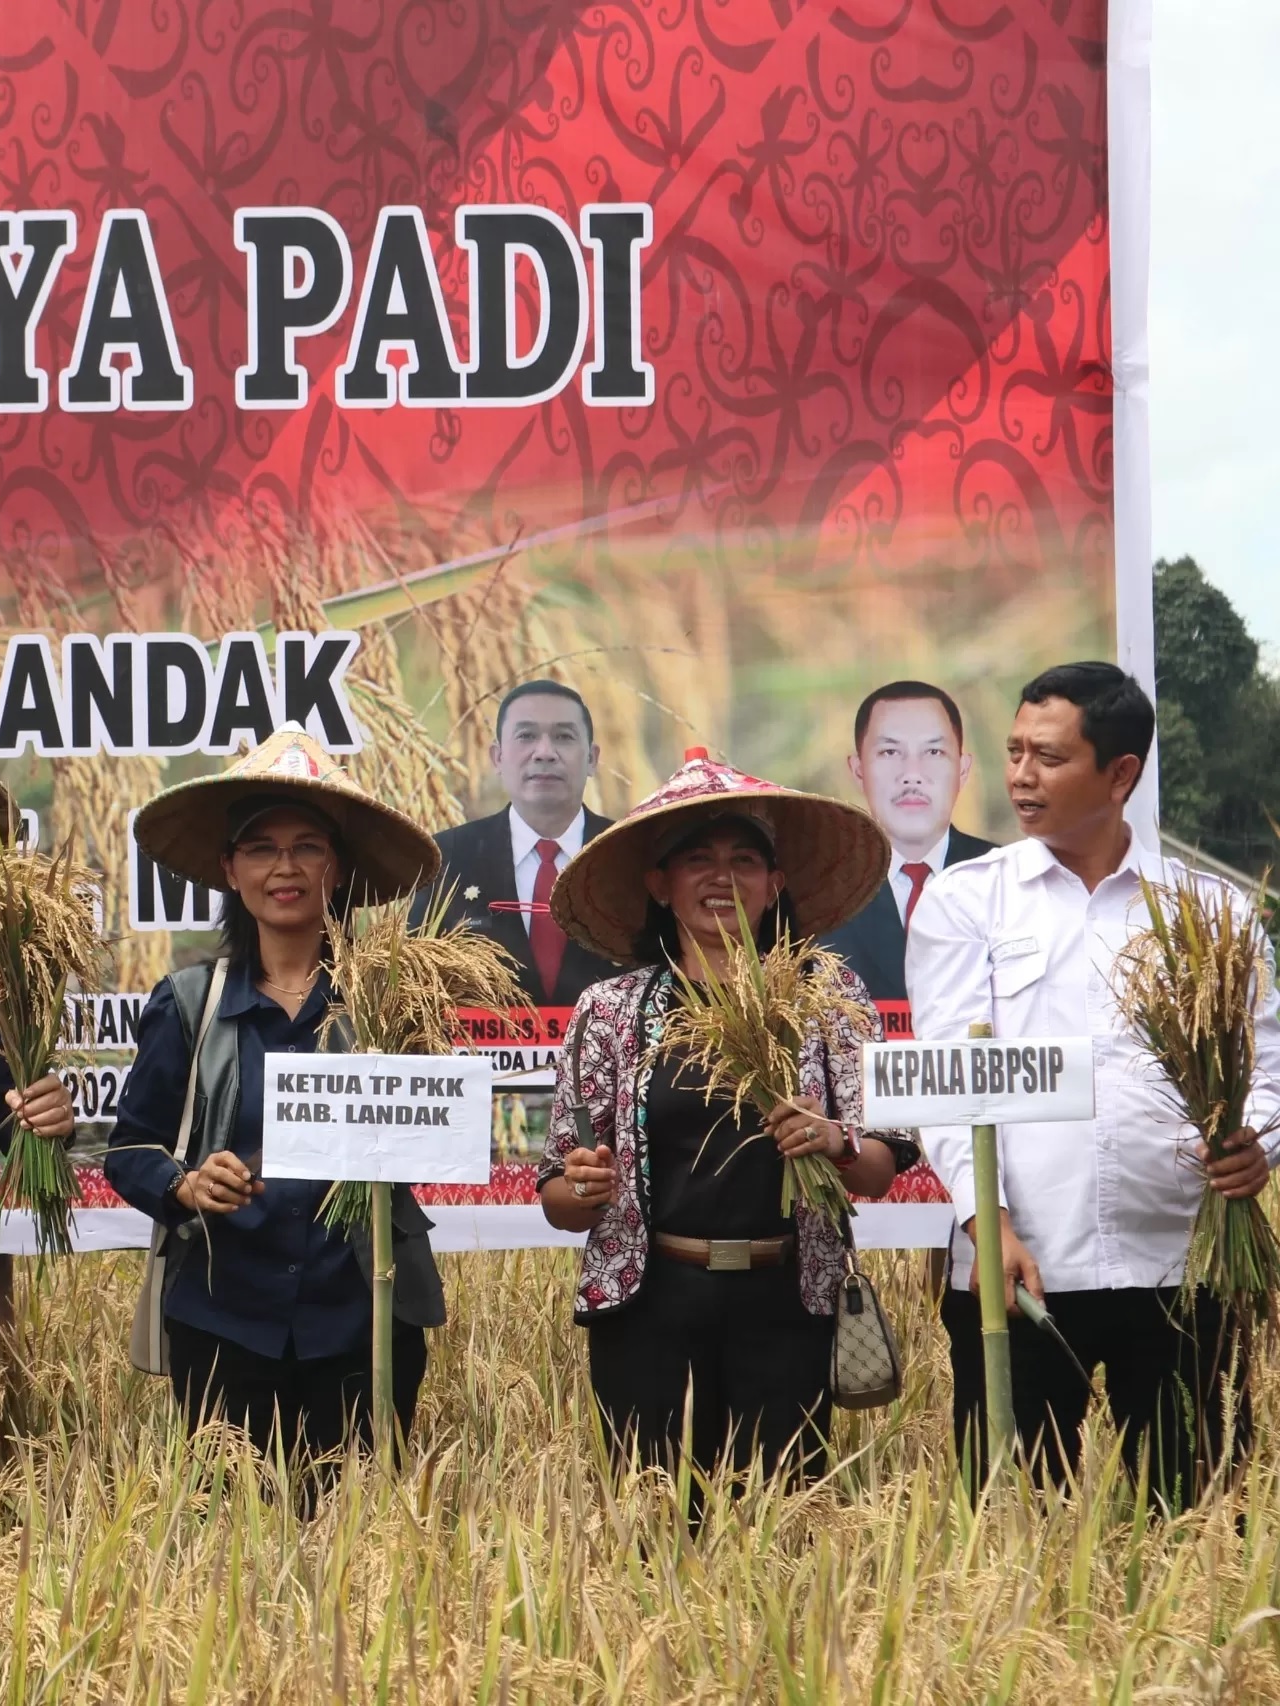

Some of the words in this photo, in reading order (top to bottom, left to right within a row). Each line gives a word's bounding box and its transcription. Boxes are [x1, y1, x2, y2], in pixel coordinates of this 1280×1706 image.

[237, 206, 653, 406] PADI
[277, 1073, 363, 1095] KETUA
[369, 1076, 403, 1096] TP
[409, 1077, 465, 1098] PKK
[874, 1049, 966, 1097] KEPALA
[971, 1046, 1065, 1095] BBPSIP
[276, 1102, 338, 1124] KAB.
[345, 1103, 451, 1126] LANDAK
